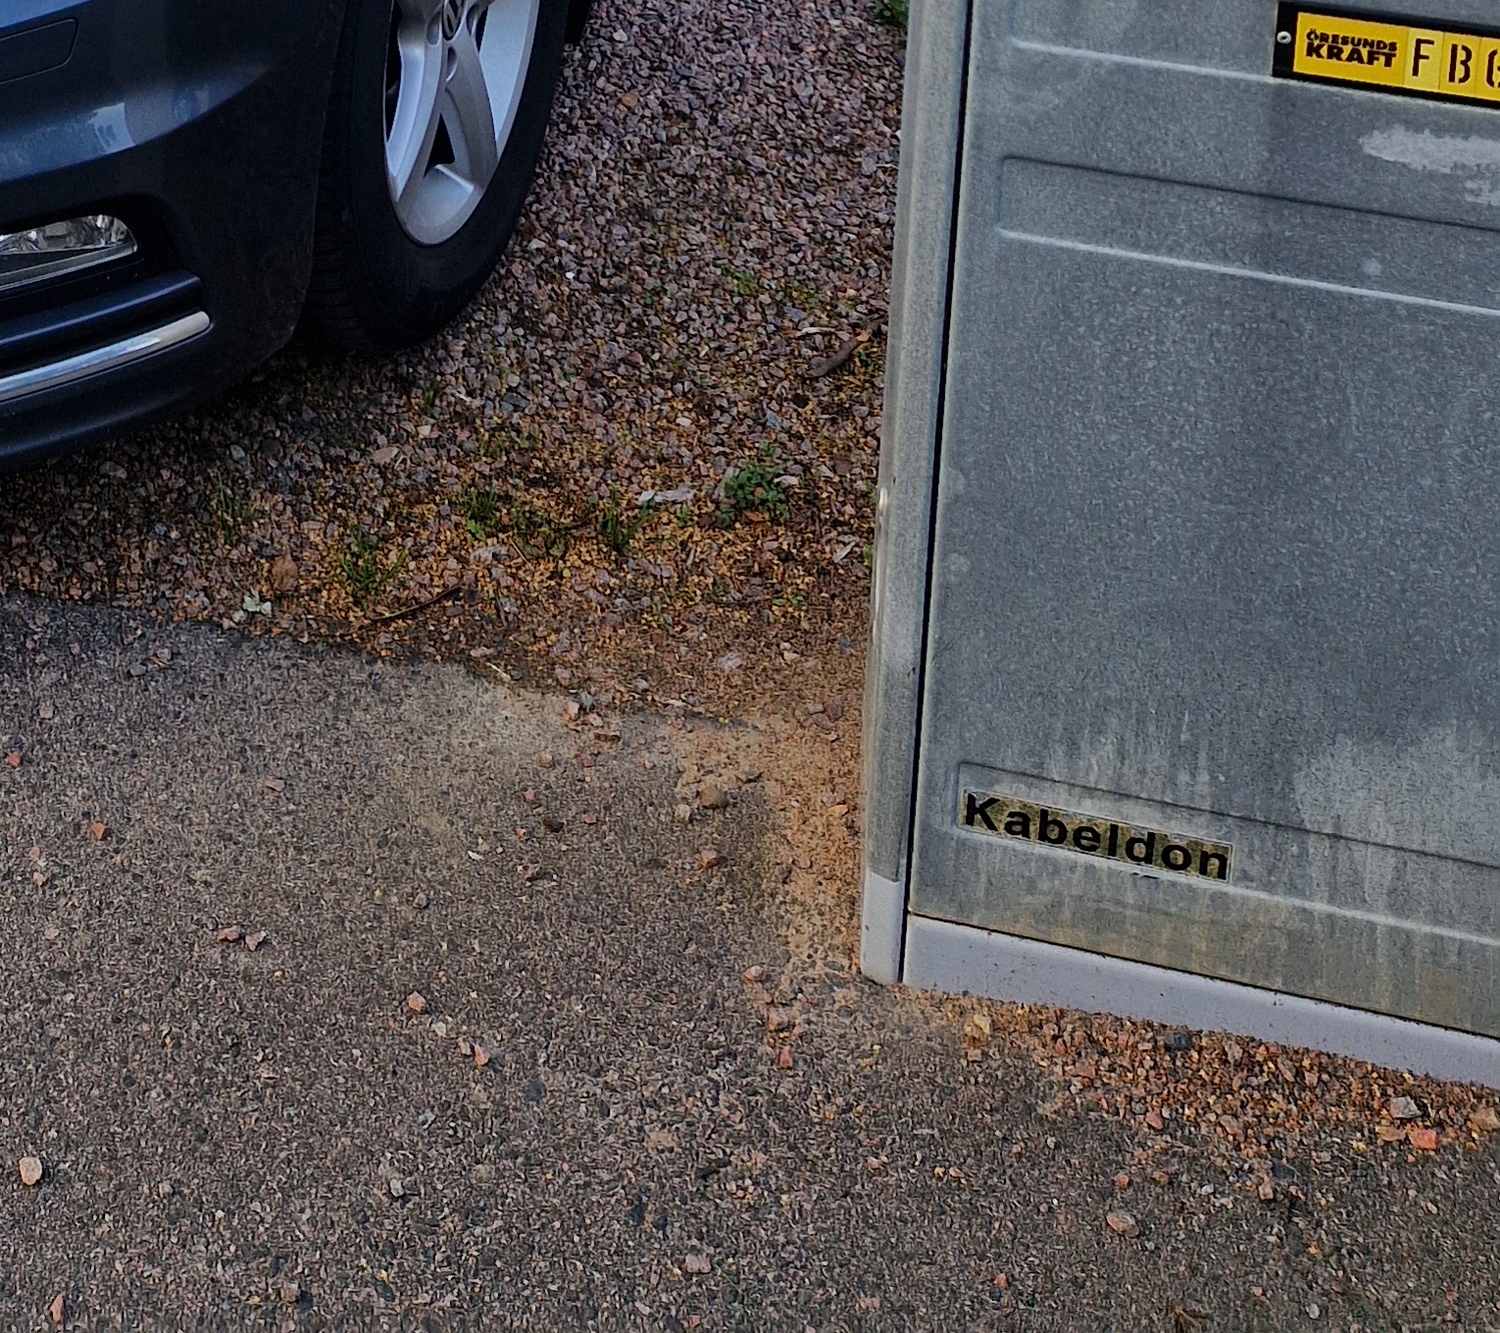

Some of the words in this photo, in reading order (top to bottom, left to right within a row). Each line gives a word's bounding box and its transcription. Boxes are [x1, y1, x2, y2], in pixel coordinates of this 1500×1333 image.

[1306, 27, 1398, 52] ÖRESUNDS
[1305, 42, 1397, 68] KRAFT
[965, 792, 1228, 882] Kabeldon
